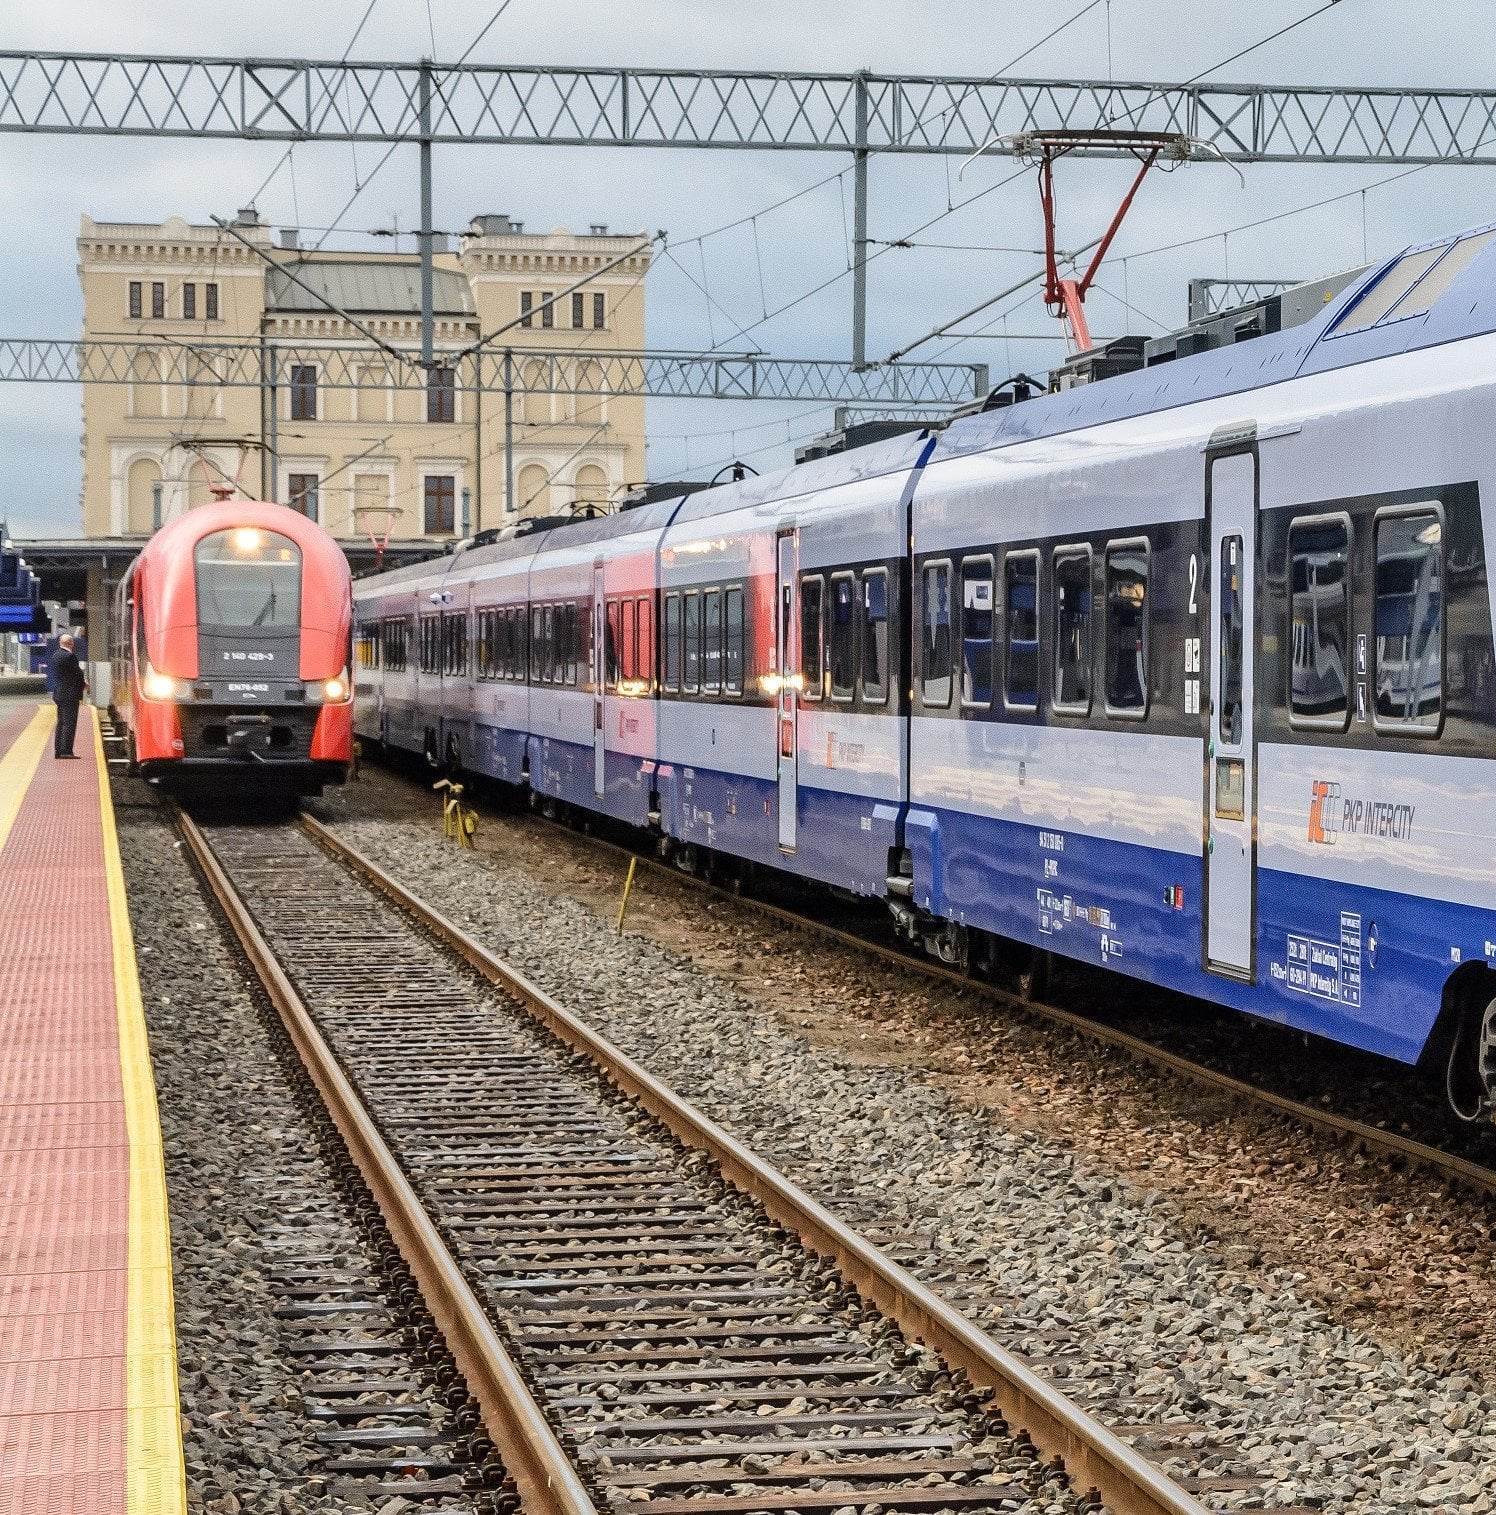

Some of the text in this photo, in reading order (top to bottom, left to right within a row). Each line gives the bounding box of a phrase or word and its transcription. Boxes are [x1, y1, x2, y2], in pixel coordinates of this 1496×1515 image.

[1188, 553, 1198, 614] 2
[1342, 798, 1416, 840] PKP INTERCITY
